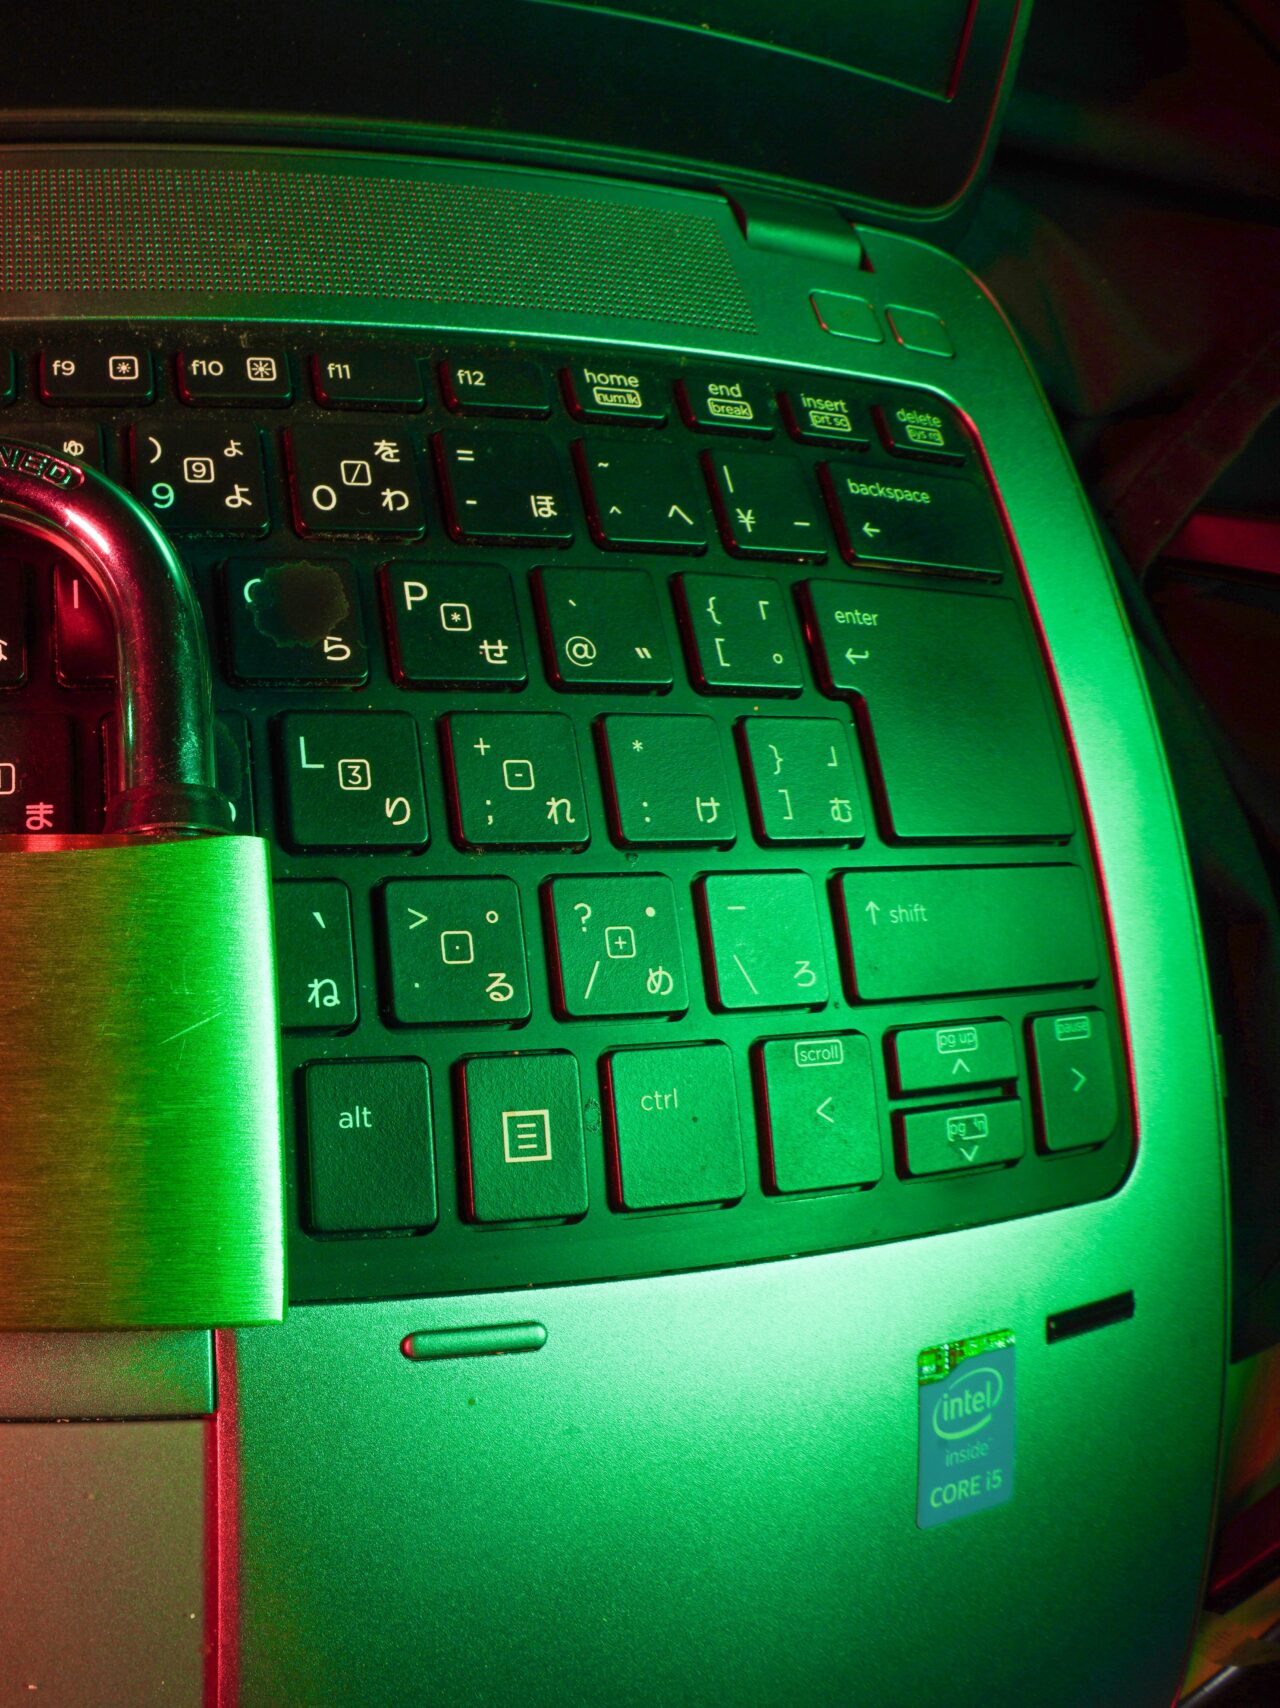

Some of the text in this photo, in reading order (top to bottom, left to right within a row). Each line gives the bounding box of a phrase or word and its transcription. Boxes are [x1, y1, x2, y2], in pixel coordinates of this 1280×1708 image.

[52, 359, 75, 376] f9
[191, 359, 224, 376] f10
[456, 369, 486, 386] f12
[583, 368, 639, 387] home
[708, 383, 742, 398] end
[800, 393, 848, 413] insert
[896, 408, 942, 427] delete
[151, 482, 175, 509] 9
[224, 484, 252, 509] よ
[381, 488, 410, 512] わ
[846, 478, 931, 504] backspace
[530, 495, 557, 518] ほ
[403, 581, 428, 611] P
[834, 609, 878, 626] enter
[479, 639, 509, 665] せ
[565, 635, 597, 667] @
[299, 736, 325, 769] L
[347, 765, 362, 785] 3
[25, 801, 54, 831] ま
[546, 797, 576, 825] れ
[695, 796, 721, 824] け
[889, 903, 928, 924] shift
[307, 978, 341, 1008] ね
[485, 972, 514, 1002] る
[646, 965, 674, 996] め
[799, 1044, 840, 1062] scroll
[640, 1087, 678, 1112] ctrl
[338, 1105, 372, 1129] alt
[942, 1381, 991, 1421] intel
[931, 1470, 1003, 1508] CORE i5
